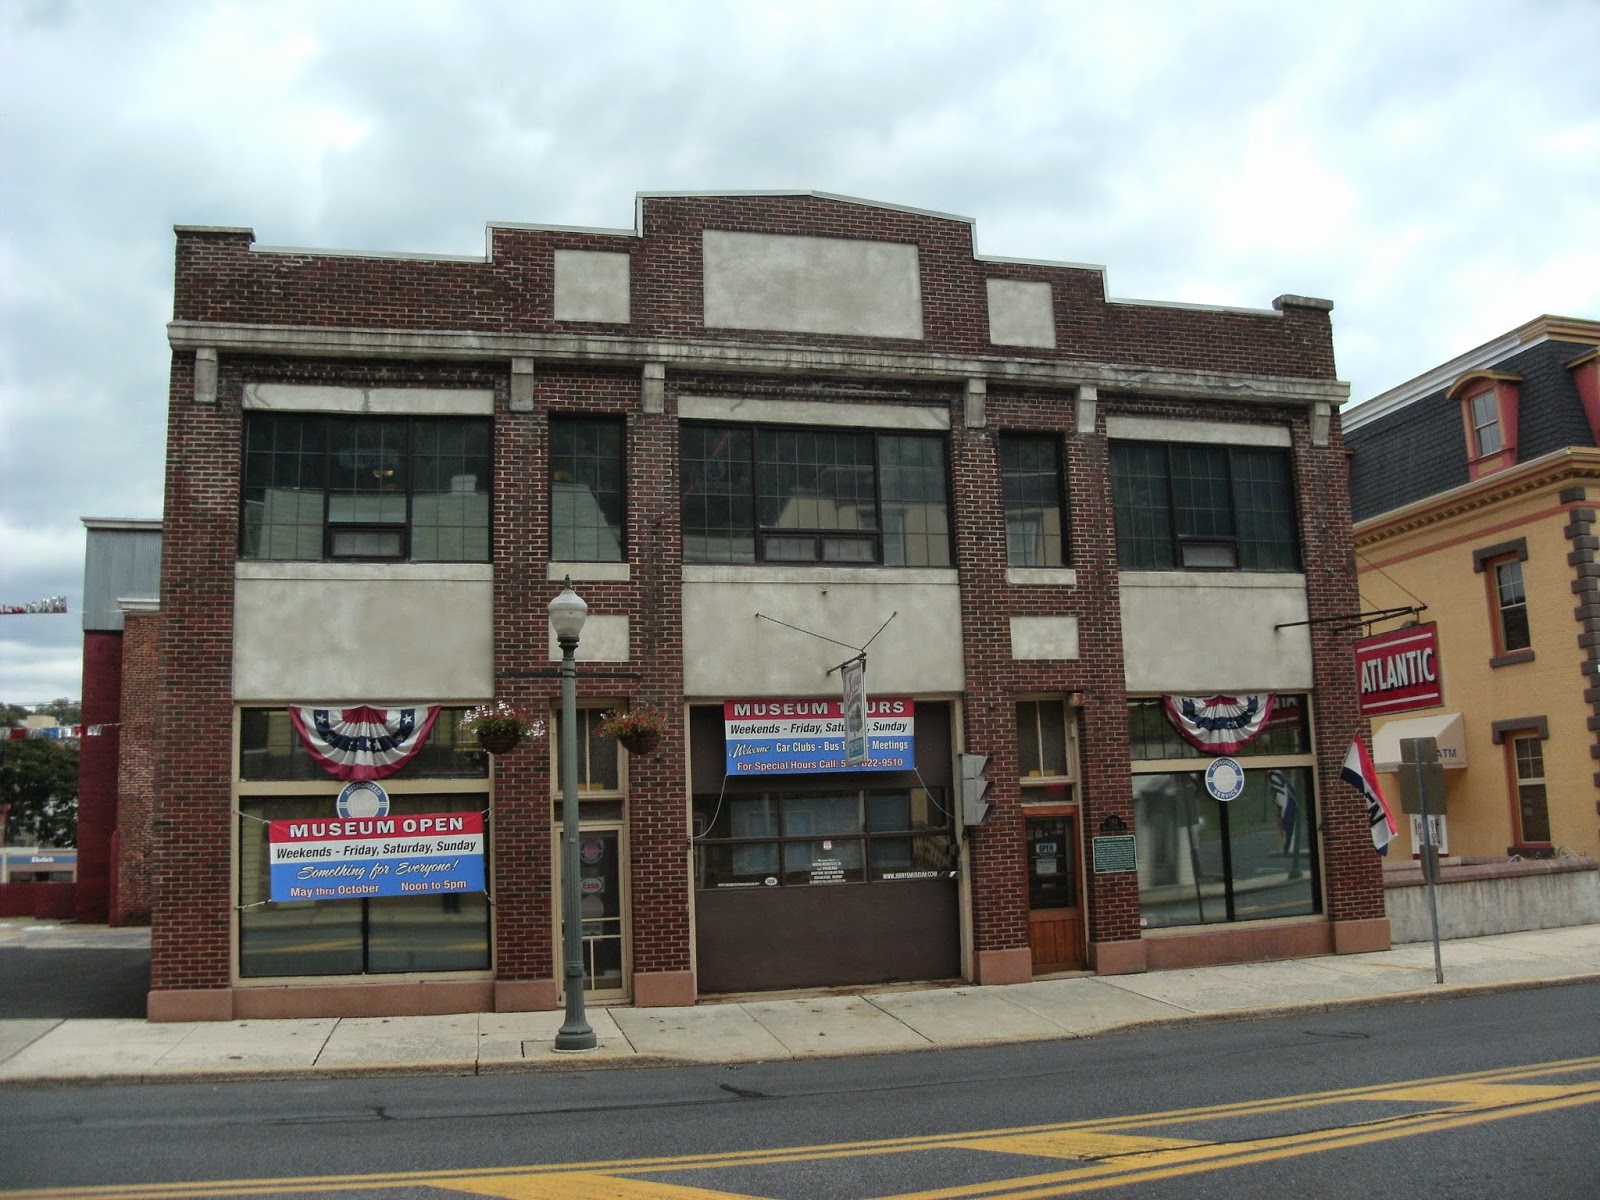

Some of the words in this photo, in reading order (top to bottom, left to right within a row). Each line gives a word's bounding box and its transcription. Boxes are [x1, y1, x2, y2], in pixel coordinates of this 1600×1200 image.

[1361, 648, 1436, 694] ATLANTIC
[734, 702, 828, 716] MUSEUM
[837, 701, 905, 714] TURS
[730, 724, 780, 734] Weekends
[790, 723, 823, 735] Friday,
[825, 722, 870, 733] Satu,
[872, 721, 908, 733] Sunday
[728, 743, 770, 758] Welcome
[776, 742, 790, 752] Car
[793, 742, 816, 752] Clubs
[824, 741, 839, 751] Bus
[872, 740, 909, 751] Meetings
[1437, 748, 1457, 758] ATM
[737, 762, 752, 771] For
[755, 761, 788, 771] Special
[790, 761, 817, 770] Hours
[819, 760, 839, 768] Call:
[1211, 759, 1238, 772] AUTHORIZED
[345, 782, 382, 796] AUTHORIZED
[1213, 787, 1239, 799] SERVICE
[289, 820, 395, 838] MUSEUM
[402, 817, 463, 833] OPEN
[277, 846, 332, 859] Weekends
[343, 844, 380, 857] Friday,
[383, 842, 433, 854] Saturday,
[436, 840, 476, 852] Sunday
[296, 864, 366, 880] Something
[369, 862, 390, 881] for
[395, 859, 459, 878] Everyone!
[290, 887, 313, 898] May
[316, 887, 335, 895] thru
[338, 884, 380, 895] October
[401, 882, 428, 891] Noon
[431, 881, 441, 889] to
[443, 880, 467, 890] 5pm
